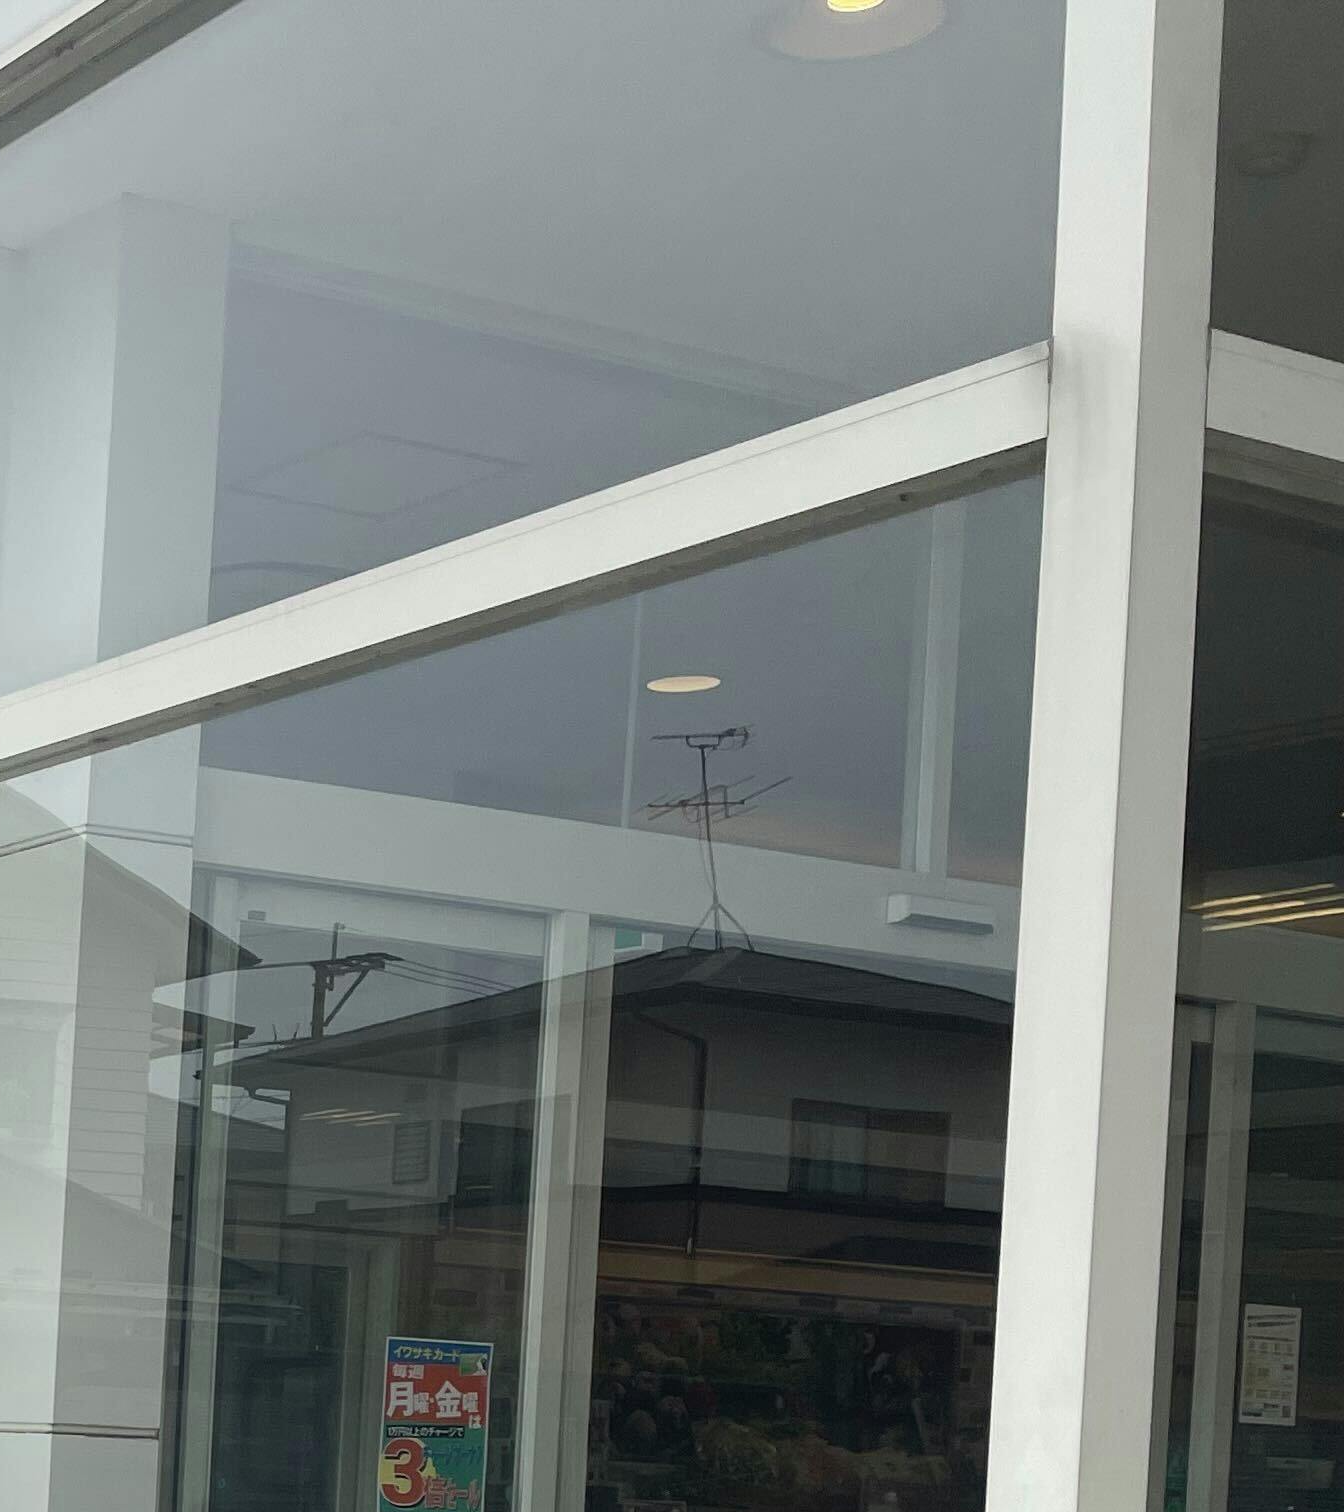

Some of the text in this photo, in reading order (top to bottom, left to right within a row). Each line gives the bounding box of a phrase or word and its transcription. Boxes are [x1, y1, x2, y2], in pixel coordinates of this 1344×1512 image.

[393, 1345, 461, 1363] イワサキカード
[391, 1364, 424, 1379] 毎週
